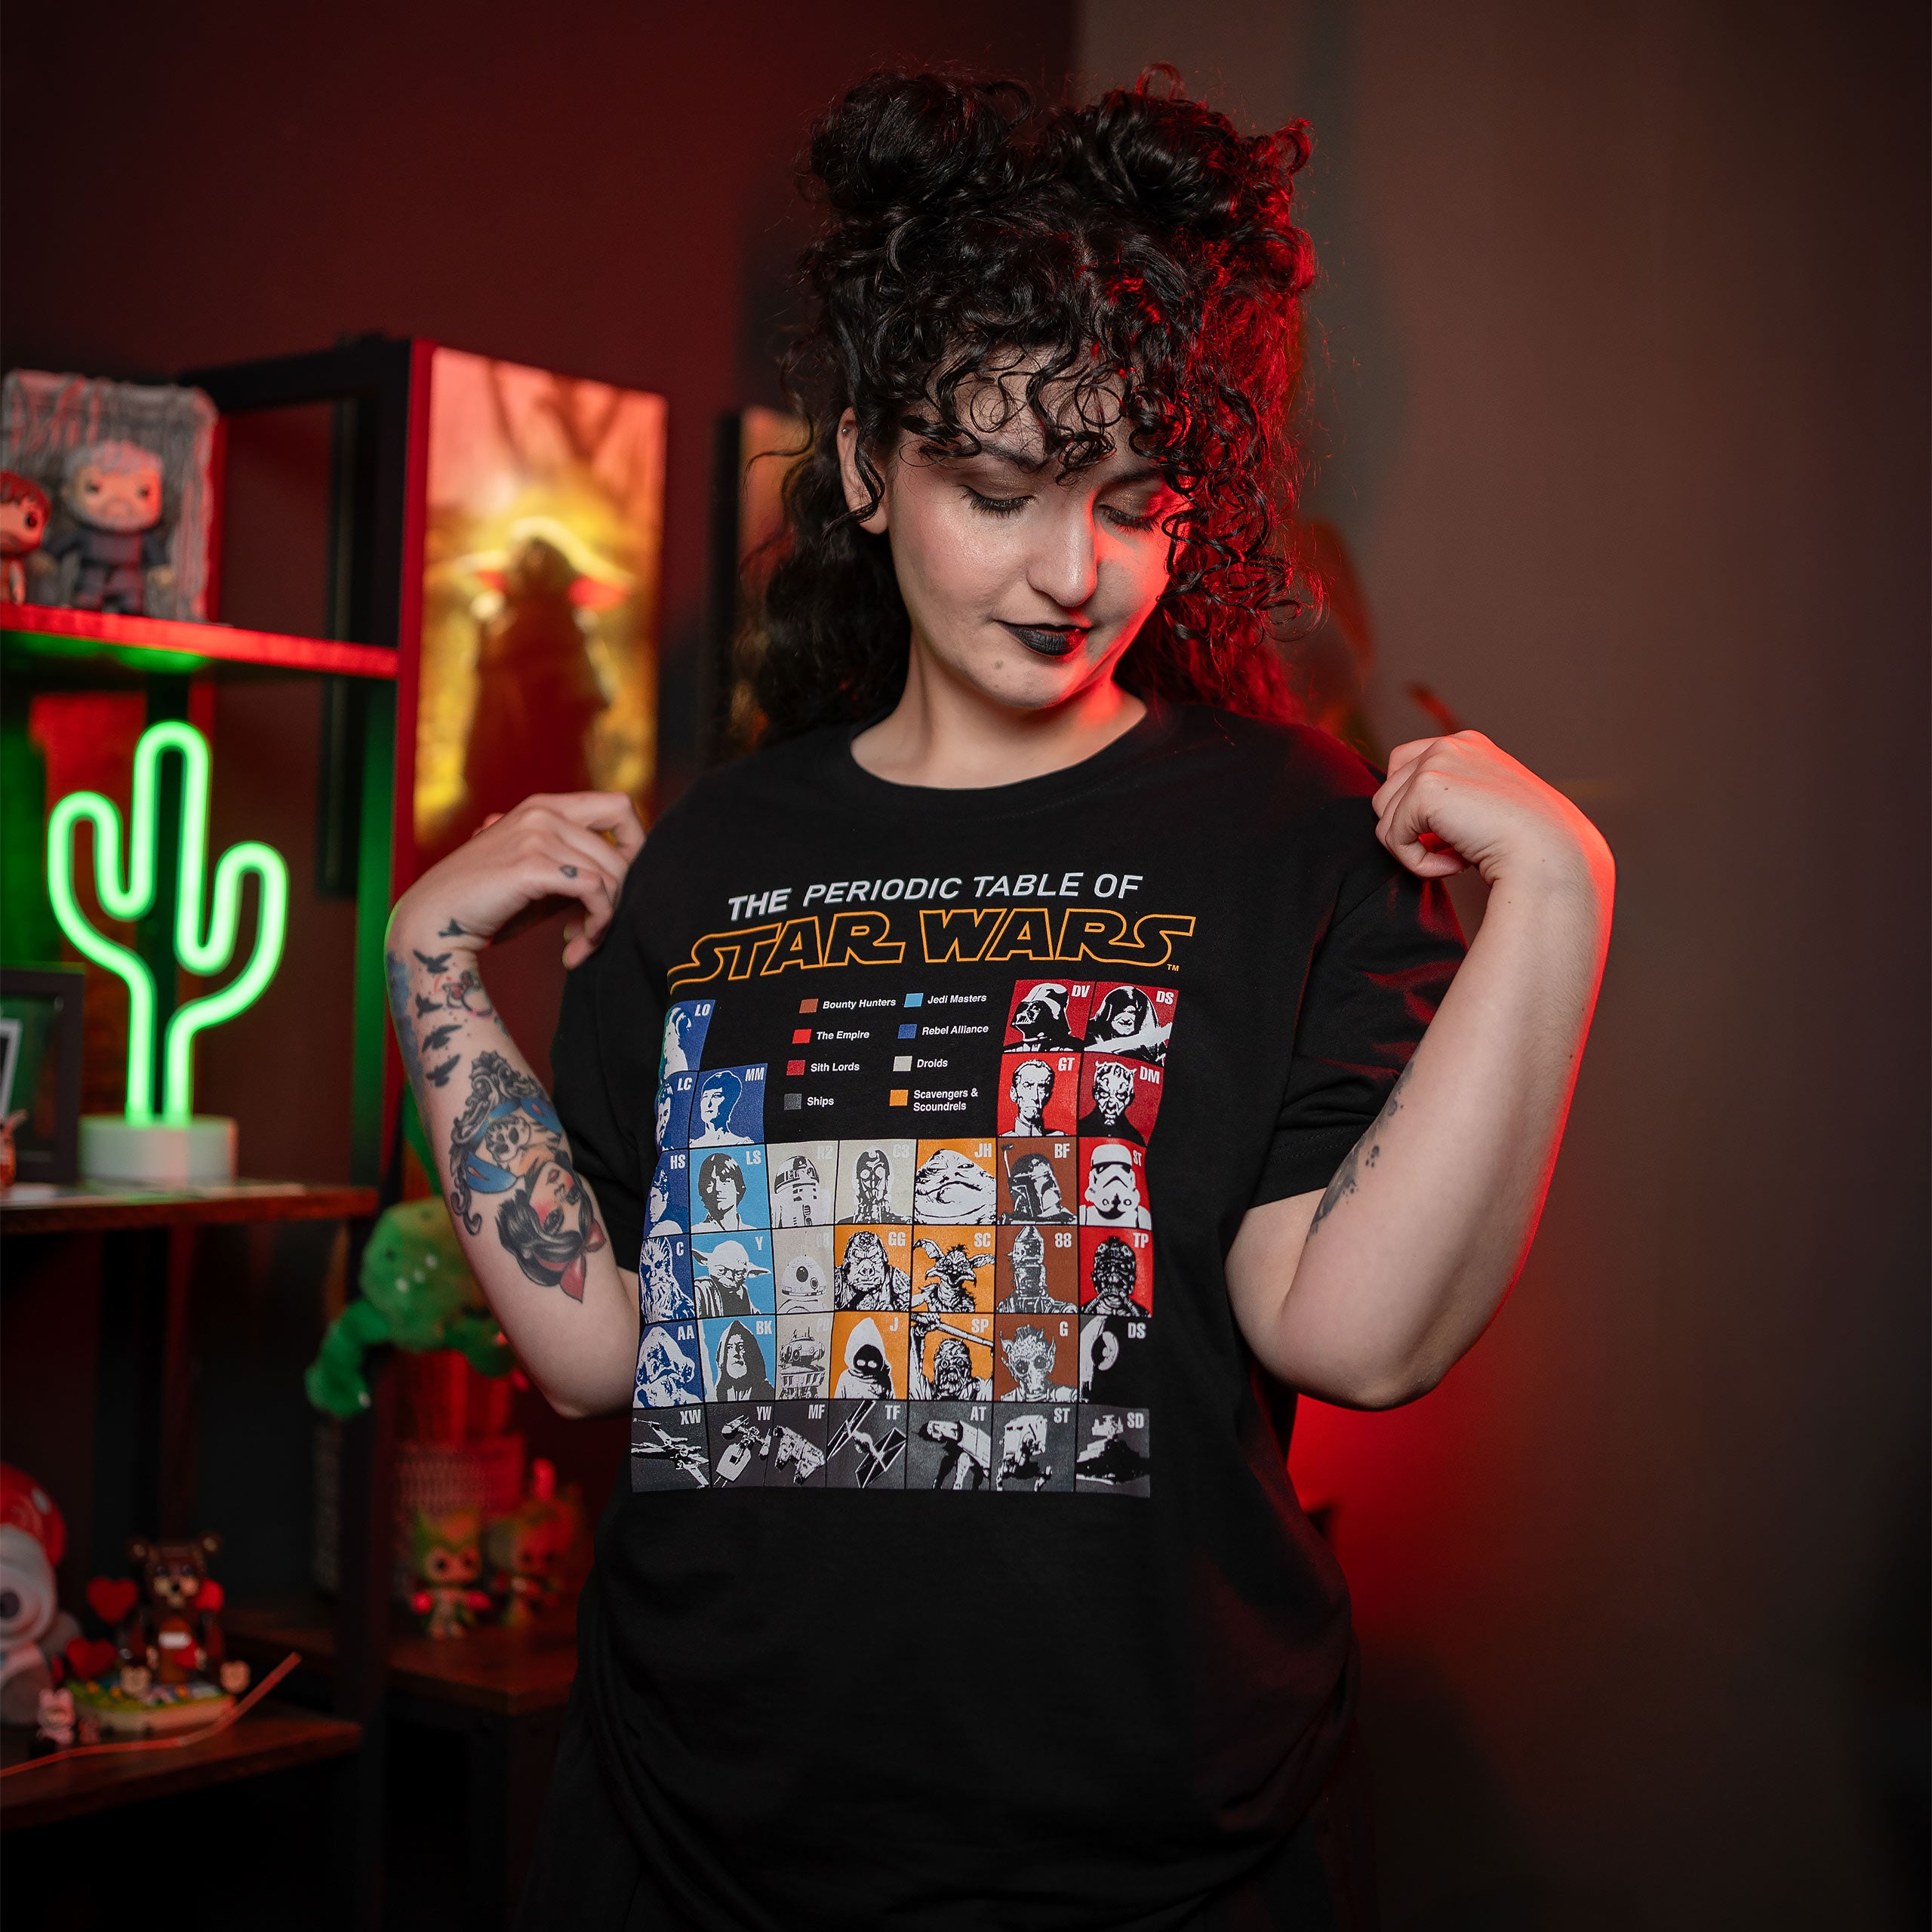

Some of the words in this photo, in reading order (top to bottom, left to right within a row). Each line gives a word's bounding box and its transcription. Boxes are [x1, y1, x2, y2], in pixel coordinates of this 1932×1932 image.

[728, 888, 792, 921] THE
[803, 877, 963, 907] PERIODIC
[973, 872, 1084, 898] TABLE
[1094, 873, 1143, 899] OF
[667, 910, 906, 995] STAR
[919, 908, 1196, 967] WARS
[1072, 984, 1091, 998] DV
[1155, 990, 1174, 1004] DS
[823, 1001, 857, 1010] Bounty
[859, 998, 897, 1008] Hunters
[928, 995, 948, 1004] Jedi
[950, 995, 987, 1004] Masters
[694, 1004, 711, 1017] LO
[816, 1032, 834, 1040] The
[836, 1030, 870, 1041] Empire
[922, 1026, 949, 1035] Rebel
[950, 1025, 989, 1034] Alliance
[811, 1063, 831, 1072] Sith
[832, 1063, 860, 1072] Lords
[917, 1059, 948, 1068] Droids
[1057, 1057, 1075, 1072] GT
[745, 1067, 764, 1081] MM
[1140, 1066, 1160, 1084] DM
[677, 1077, 693, 1091] LC
[913, 1088, 968, 1100] Scavengers
[971, 1088, 978, 1097] &
[807, 1097, 834, 1107] Ships
[913, 1102, 967, 1112] Scoundrels
[746, 1149, 761, 1166] LS
[974, 1143, 992, 1158] JH
[1054, 1143, 1070, 1158] BF
[1132, 1149, 1143, 1167] ST
[669, 1154, 685, 1170] HS
[755, 1235, 763, 1251] Y
[888, 1231, 906, 1246] GG
[974, 1232, 991, 1247] SC
[1054, 1232, 1072, 1248] 88
[1132, 1232, 1149, 1246] TP
[676, 1241, 684, 1257] C
[755, 1320, 772, 1335] BK
[889, 1318, 898, 1331] J
[971, 1318, 989, 1334] SP
[1059, 1321, 1069, 1337] G
[1128, 1322, 1146, 1339] DS
[677, 1324, 694, 1341] AA
[680, 1408, 701, 1426] XW
[756, 1406, 772, 1421] YW
[808, 1404, 826, 1420] MF
[885, 1404, 900, 1420] TF
[970, 1406, 987, 1422] AT
[1054, 1407, 1070, 1423] ST
[1127, 1411, 1144, 1428] SD
